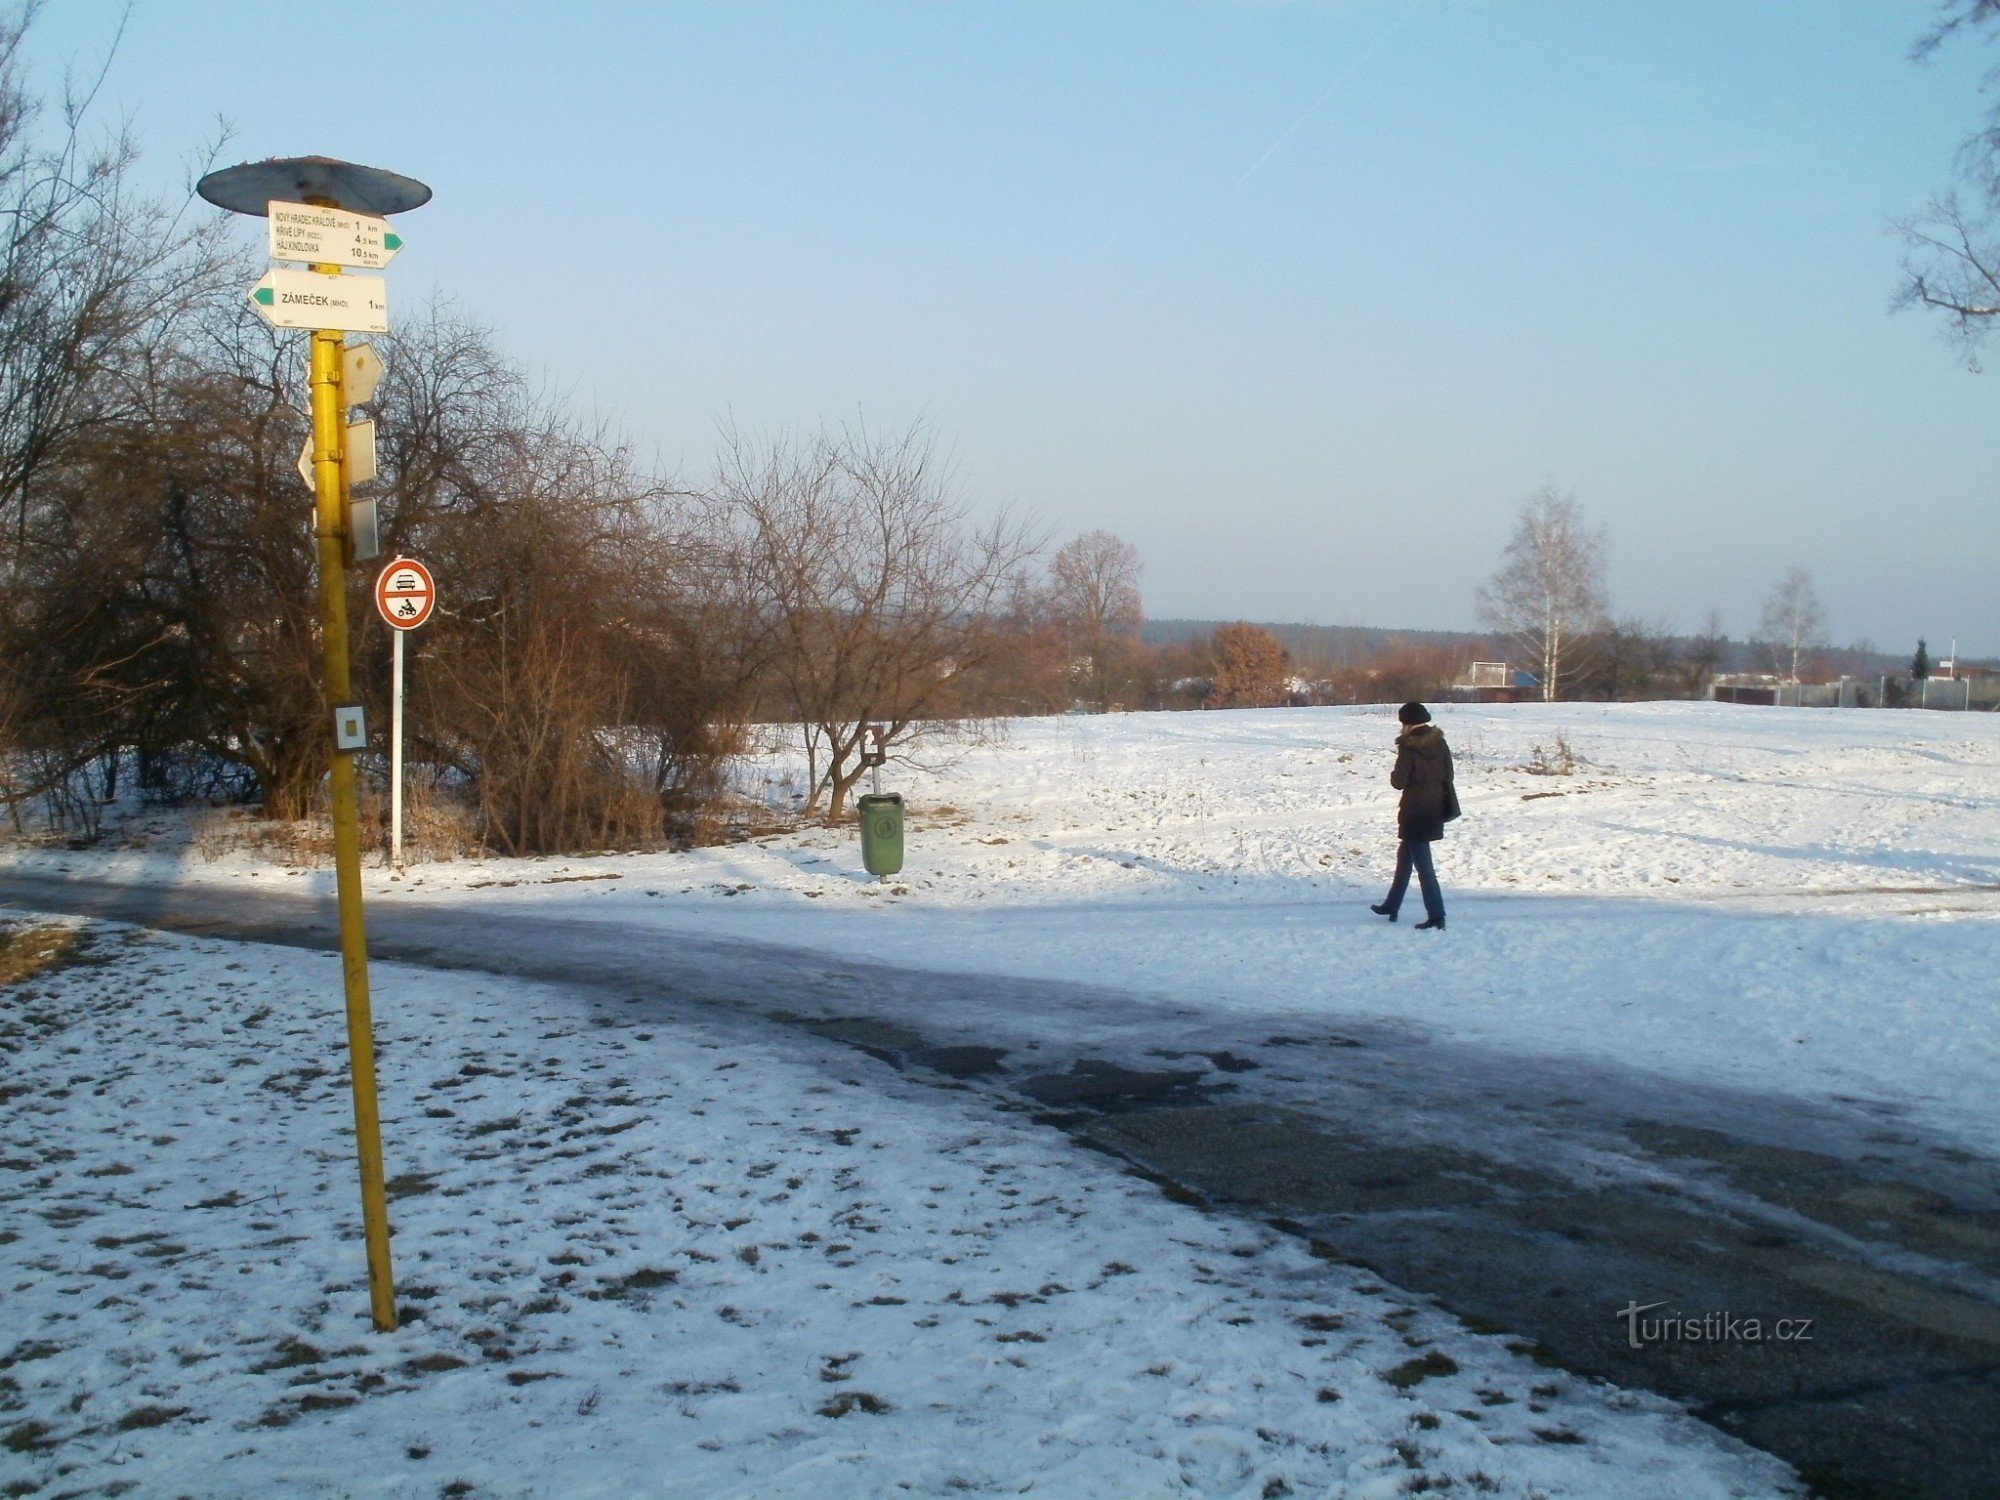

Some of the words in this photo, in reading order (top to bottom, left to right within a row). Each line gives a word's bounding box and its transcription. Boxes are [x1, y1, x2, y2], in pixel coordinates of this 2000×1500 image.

[276, 211, 289, 222] NOVÝ
[291, 213, 311, 226] HRADEC
[355, 221, 360, 230] 1
[294, 227, 306, 238] LIPY
[368, 237, 378, 245] km
[368, 251, 379, 260] km
[282, 292, 329, 306] ZÁMEČEK
[330, 299, 348, 309] (MHD)
[369, 300, 373, 309] 1
